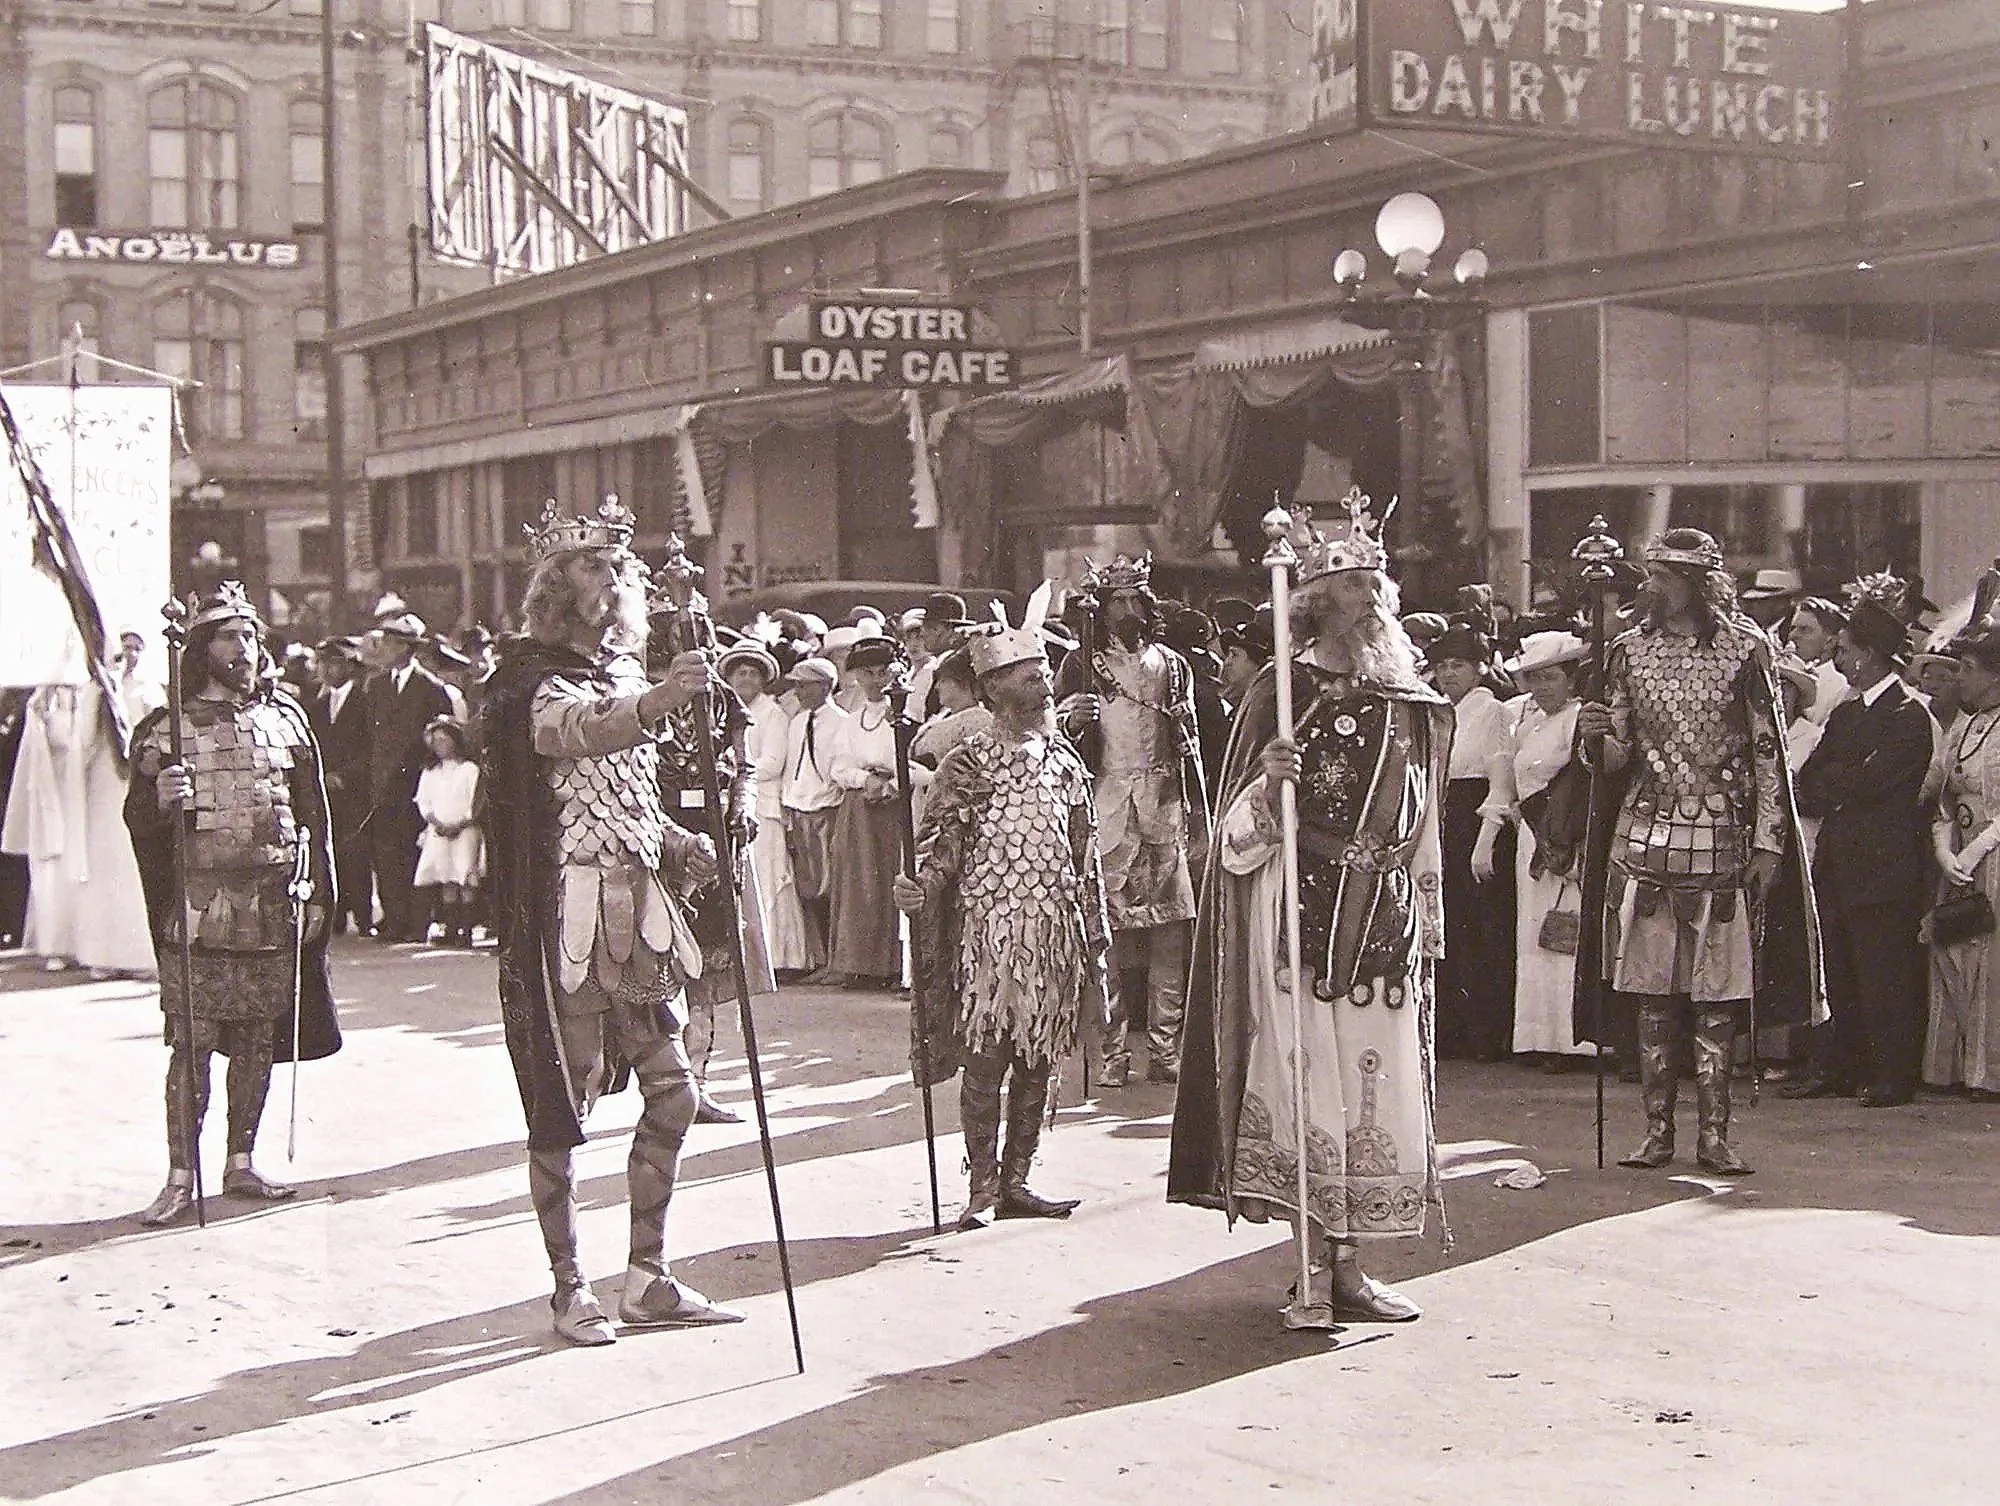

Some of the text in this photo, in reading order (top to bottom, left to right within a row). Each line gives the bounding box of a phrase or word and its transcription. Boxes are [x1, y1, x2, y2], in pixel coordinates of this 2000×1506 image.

[1448, 0, 1780, 76] WHITE
[1390, 49, 1592, 127] DAIRY
[1626, 72, 1829, 147] LUNCH
[819, 305, 968, 341] OYSTER
[772, 347, 1011, 384] LOAF CAFE
